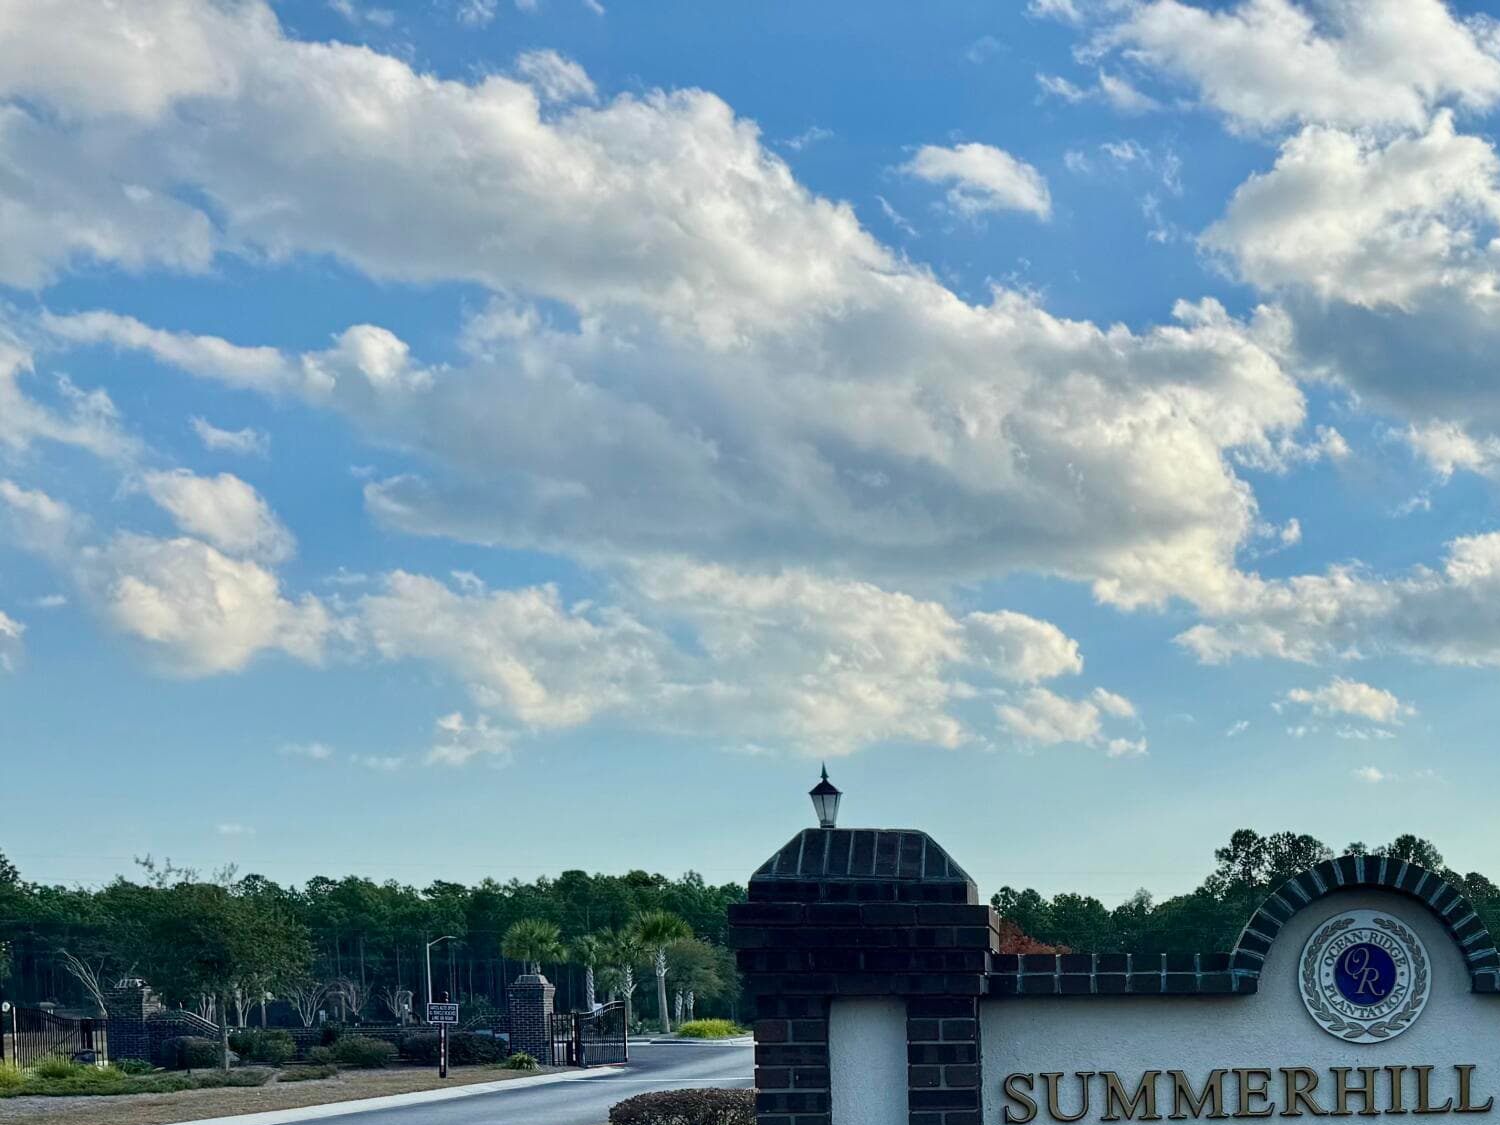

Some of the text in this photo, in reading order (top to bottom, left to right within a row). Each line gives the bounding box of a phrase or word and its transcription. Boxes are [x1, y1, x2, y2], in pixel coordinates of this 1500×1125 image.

[1324, 930, 1407, 968] OCEAN RIDGE
[1324, 983, 1406, 1018] PLANTATION
[1003, 1064, 1494, 1125] SUMMERHILL
